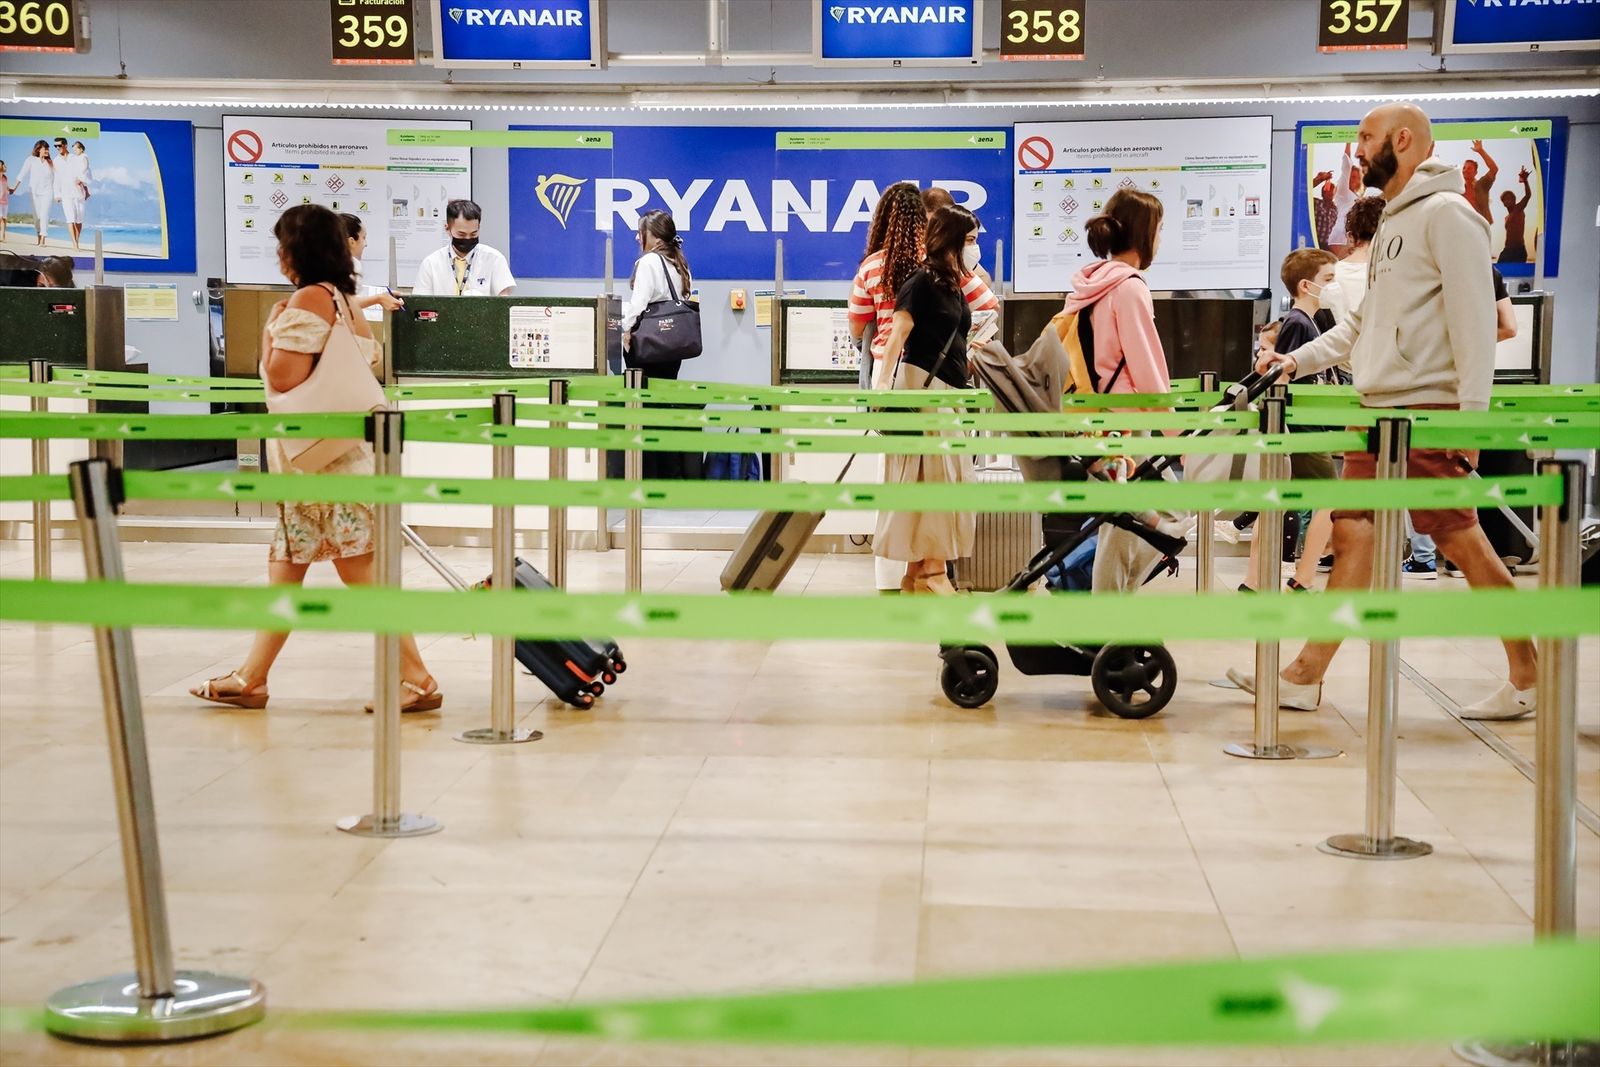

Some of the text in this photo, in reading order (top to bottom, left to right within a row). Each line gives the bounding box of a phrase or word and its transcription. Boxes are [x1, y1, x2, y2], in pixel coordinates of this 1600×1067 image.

[0, 1, 70, 35] 360
[338, 15, 408, 48] 359
[466, 9, 583, 26] RYANAIR
[847, 6, 967, 24] RYANAIR
[1007, 9, 1081, 43] 358
[1327, 0, 1402, 34] 357
